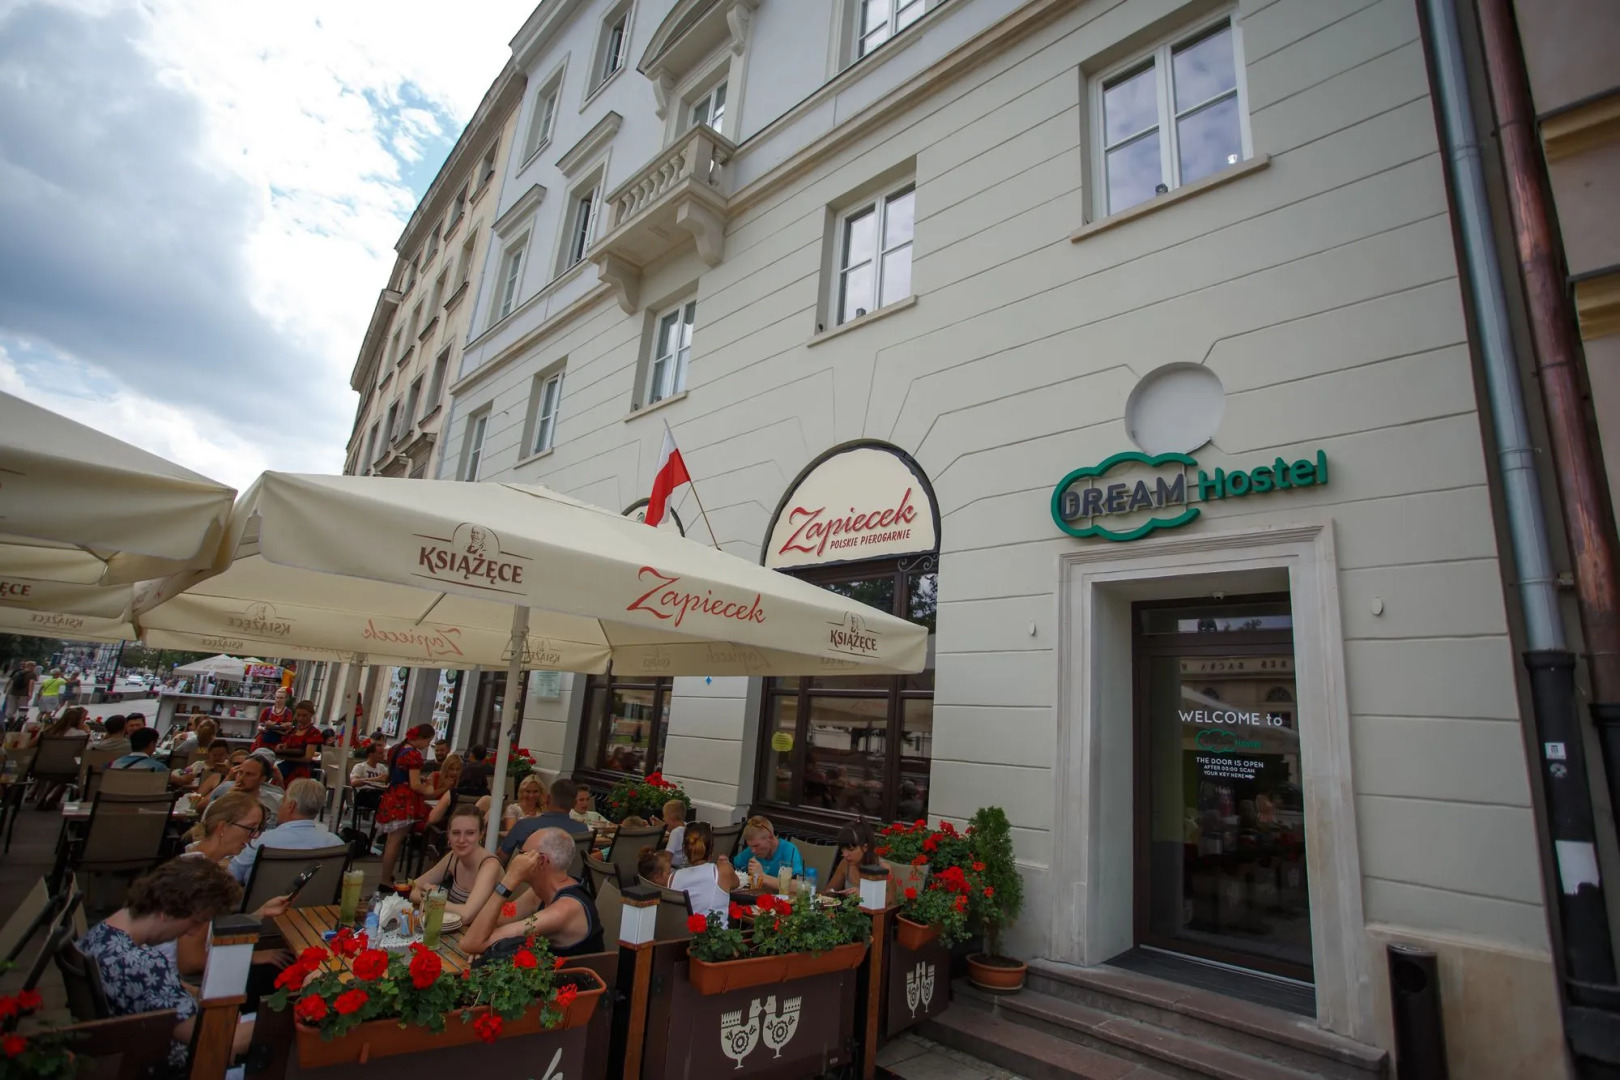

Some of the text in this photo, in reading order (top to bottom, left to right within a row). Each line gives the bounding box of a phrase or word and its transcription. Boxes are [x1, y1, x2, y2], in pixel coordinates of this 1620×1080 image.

[1061, 449, 1329, 521] DREAM Hostel
[778, 488, 917, 556] Zapiecek
[830, 529, 911, 550] POLSKIE PIEROGARNIE
[418, 546, 524, 584] KSIĄŻĘCE
[626, 566, 766, 627] Zapiecek
[829, 628, 878, 652] KSIĄŻĘCE
[1178, 710, 1283, 726] WELCOME to
[1211, 758, 1232, 766] DOOR
[1234, 759, 1241, 767] IS
[1243, 760, 1264, 768] OPEN
